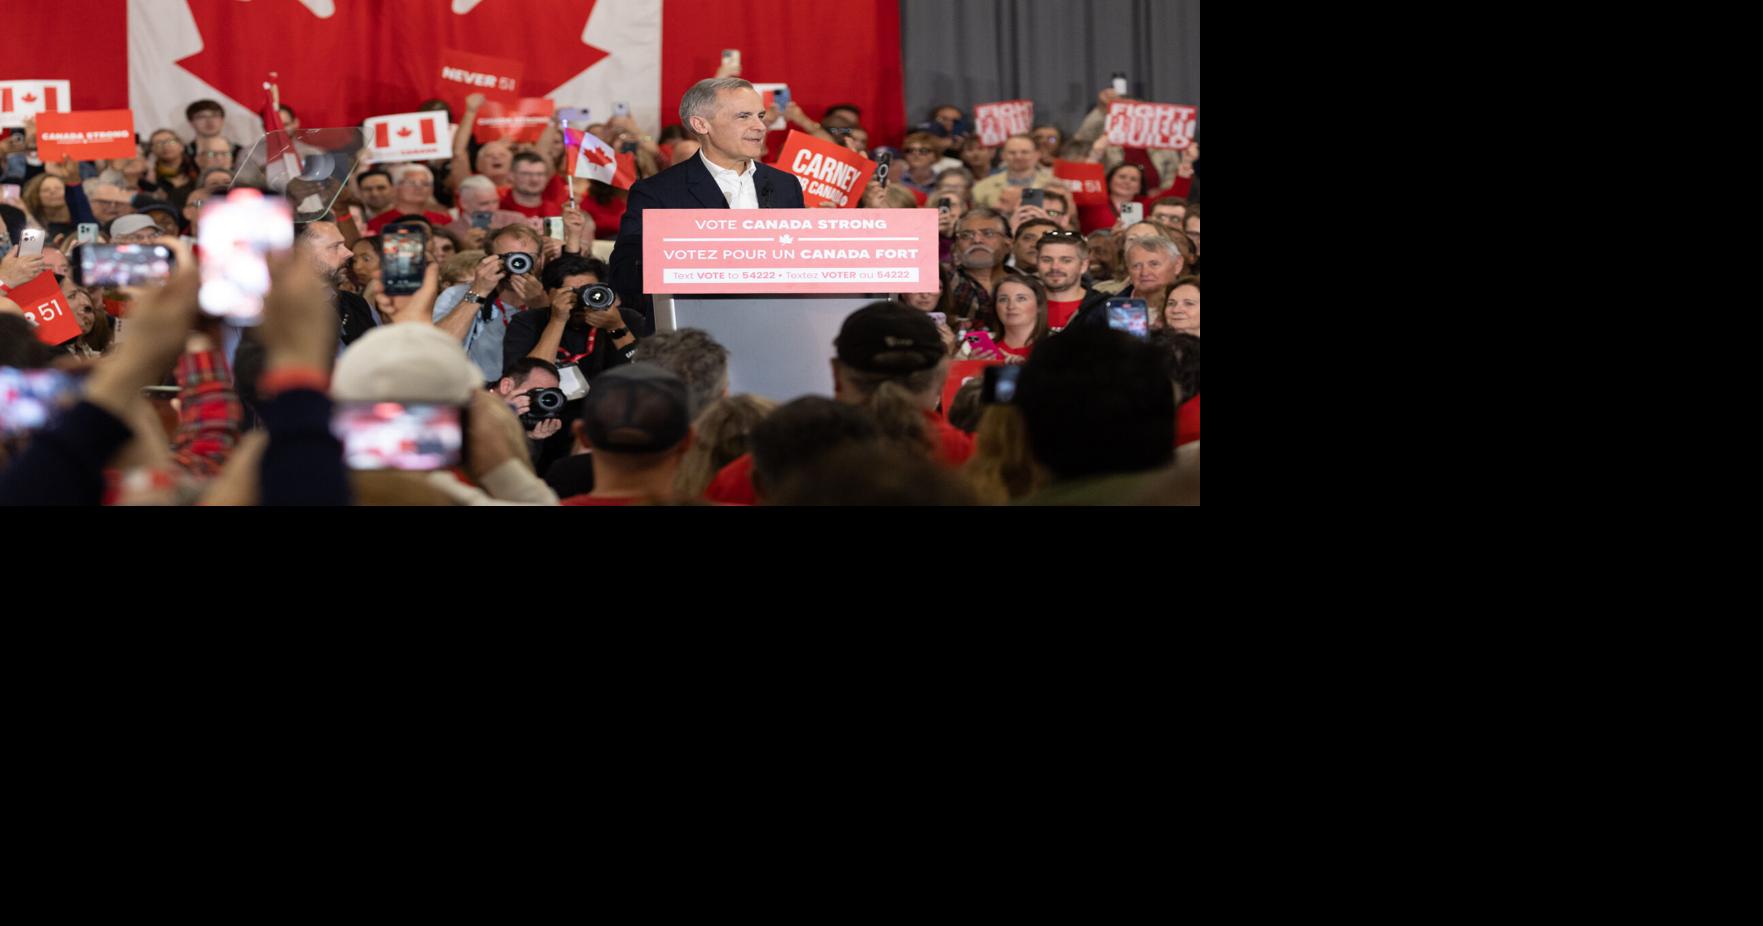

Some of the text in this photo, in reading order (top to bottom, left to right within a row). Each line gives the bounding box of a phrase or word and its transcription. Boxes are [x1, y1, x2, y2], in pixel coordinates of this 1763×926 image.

[442, 66, 497, 88] NEVER
[42, 132, 84, 141] CANADA
[86, 130, 129, 140] STRONG
[792, 148, 861, 193] CARNEY
[695, 219, 887, 230] VOTE CANADA STRONG
[663, 248, 919, 260] VOTEZ POUR UN CANADA FORT
[672, 271, 694, 280] Text
[697, 271, 725, 280] VOTE
[728, 271, 740, 280] to
[742, 271, 776, 280] 54222
[786, 270, 818, 279] Textez
[820, 270, 857, 279] VOTER
[877, 270, 910, 279] 54222
[37, 298, 64, 321] 51
